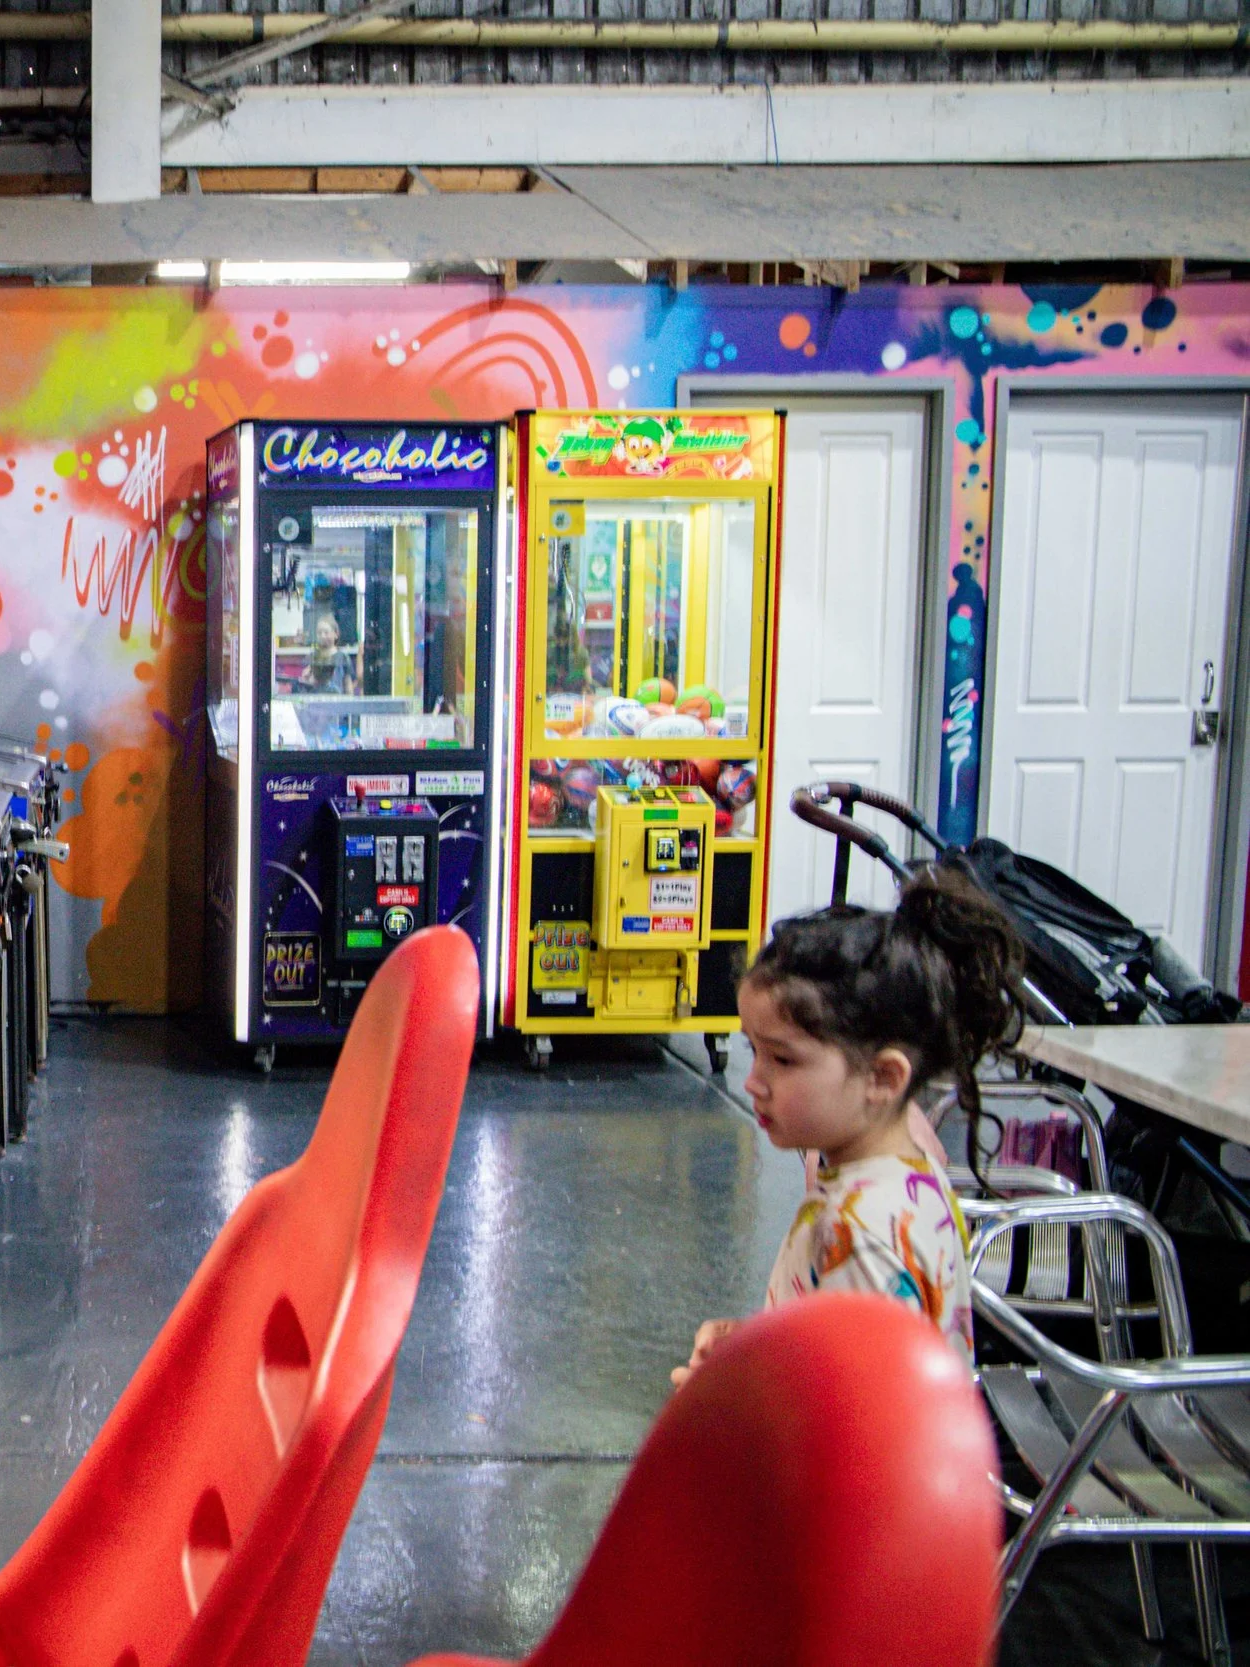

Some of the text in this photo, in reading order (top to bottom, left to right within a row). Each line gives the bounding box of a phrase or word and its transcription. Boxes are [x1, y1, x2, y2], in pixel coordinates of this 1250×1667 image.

[263, 427, 488, 473] Chocoholic
[266, 943, 315, 966] PRIZE
[274, 964, 306, 986] OUT
